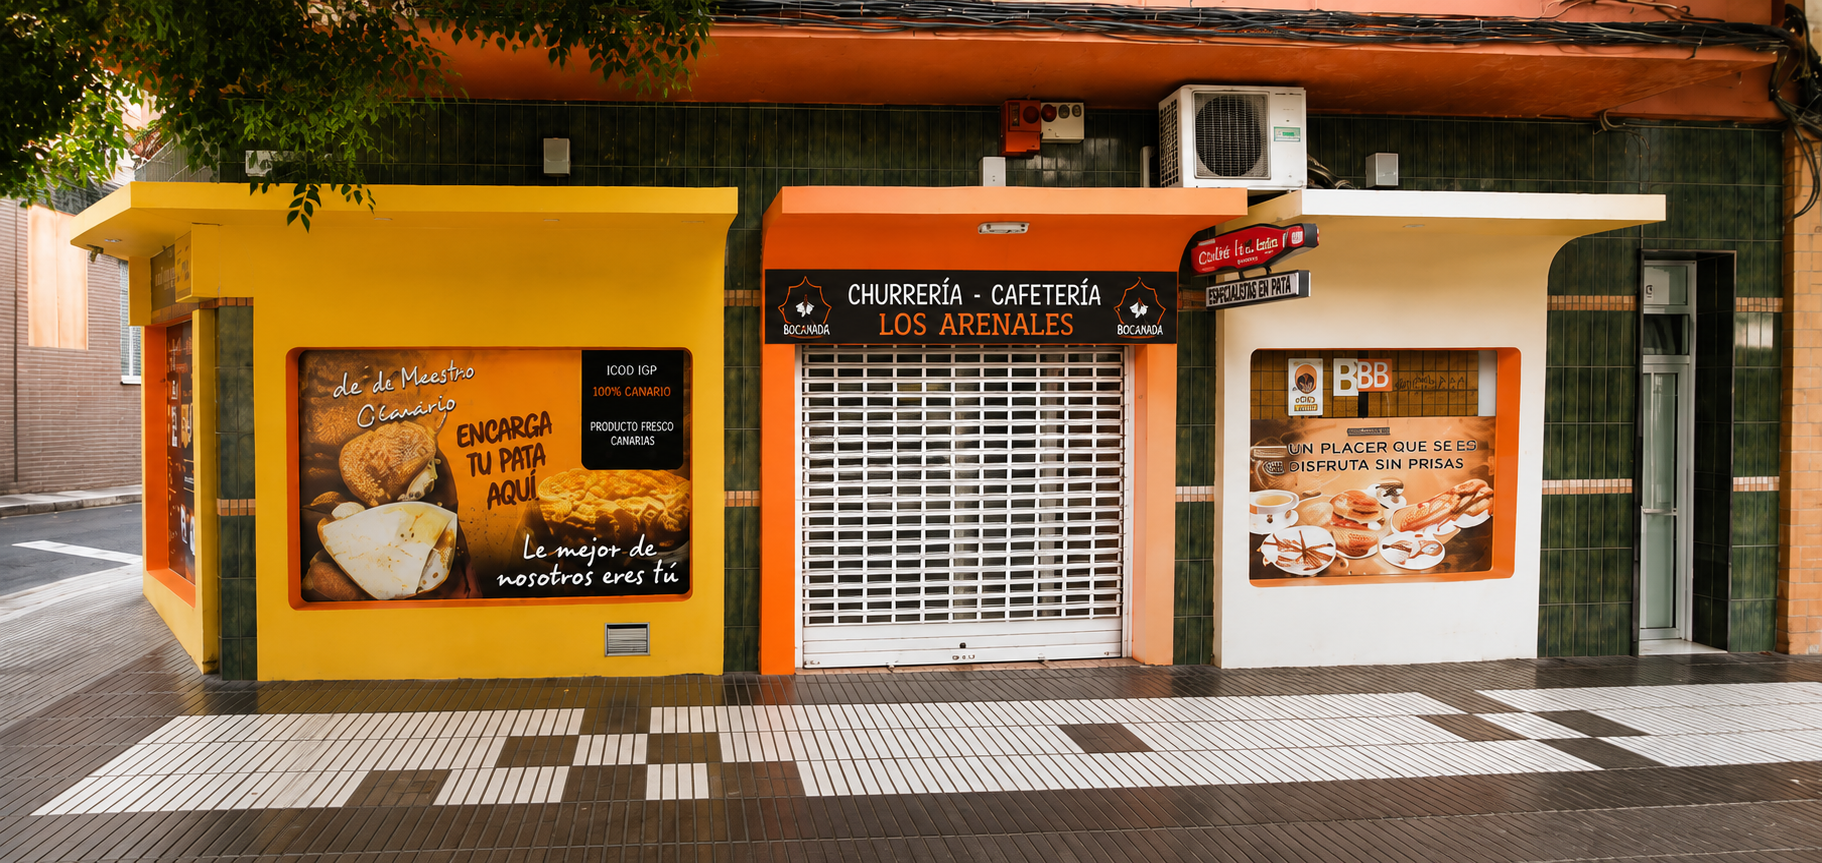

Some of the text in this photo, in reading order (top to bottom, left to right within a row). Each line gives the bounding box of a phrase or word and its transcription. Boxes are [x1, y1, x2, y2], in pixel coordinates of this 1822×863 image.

[848, 277, 963, 306] CHURRERÍA
[991, 278, 1102, 306] CAFETERÍA
[1258, 280, 1269, 298] EN
[1271, 275, 1291, 296] PATA
[783, 324, 831, 335] BOCANADA
[879, 313, 1074, 336] LOS ARENALES
[1117, 324, 1164, 335] BOCANADA
[607, 365, 657, 376] ICOD IGP
[592, 386, 671, 397] 100% CANARIO
[457, 411, 552, 448] ENCARGA
[590, 421, 674, 432] PRODUCTO FRESCO
[611, 435, 655, 446] CANARIAS
[1288, 443, 1313, 456] UN
[1321, 442, 1388, 454] PLACER
[1393, 441, 1427, 453] QUE
[466, 442, 546, 477] TU PATA
[1289, 459, 1369, 472] DISFRUTA
[1375, 458, 1401, 470] SIN
[1409, 458, 1464, 470] PRISAS
[523, 533, 657, 567] Le mejor de
[496, 559, 679, 588] nosotros eres tú
